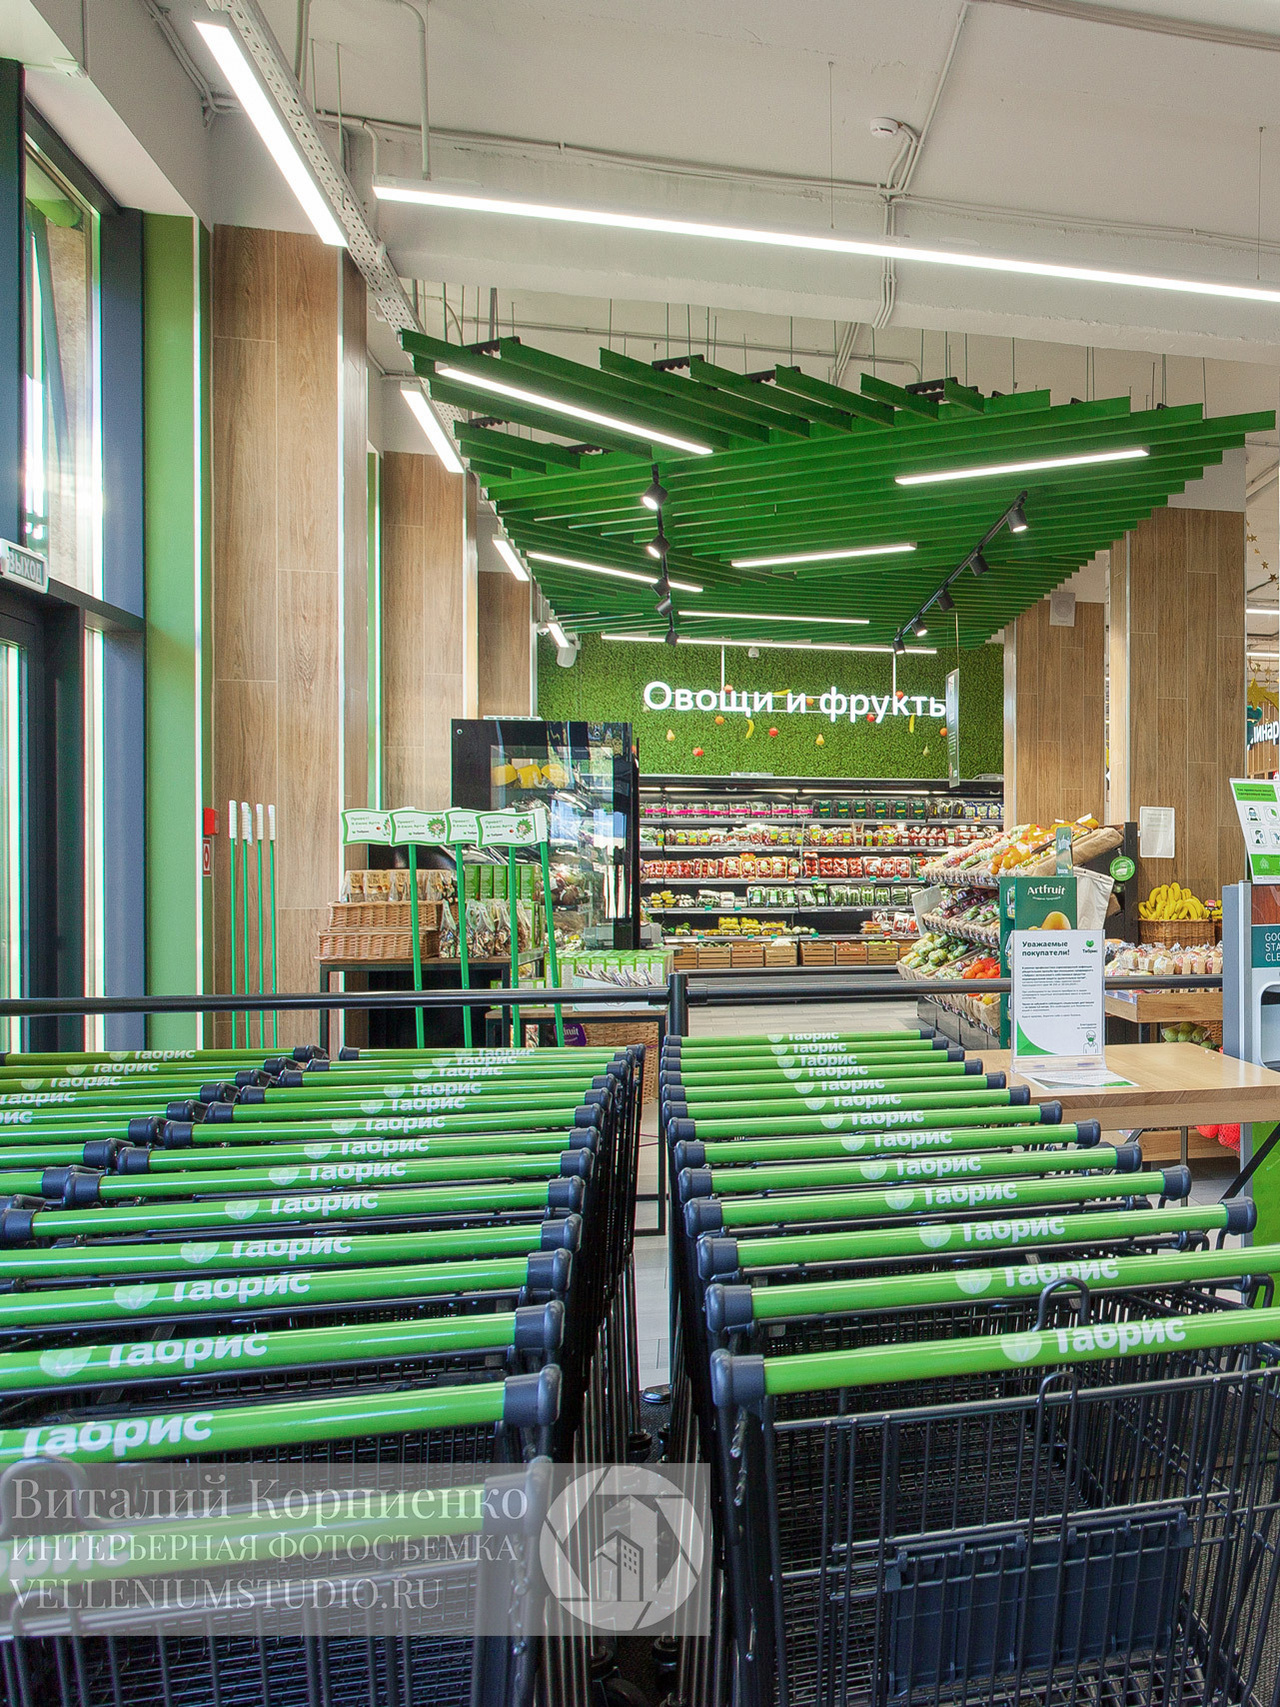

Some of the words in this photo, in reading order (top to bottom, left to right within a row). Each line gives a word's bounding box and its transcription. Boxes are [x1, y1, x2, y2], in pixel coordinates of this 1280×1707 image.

[8, 549, 44, 587] ВЫХОД
[643, 680, 774, 717] Овощи
[786, 692, 807, 715] и
[1027, 884, 1066, 896] Artfruit
[1021, 949, 1070, 957] покупатели!
